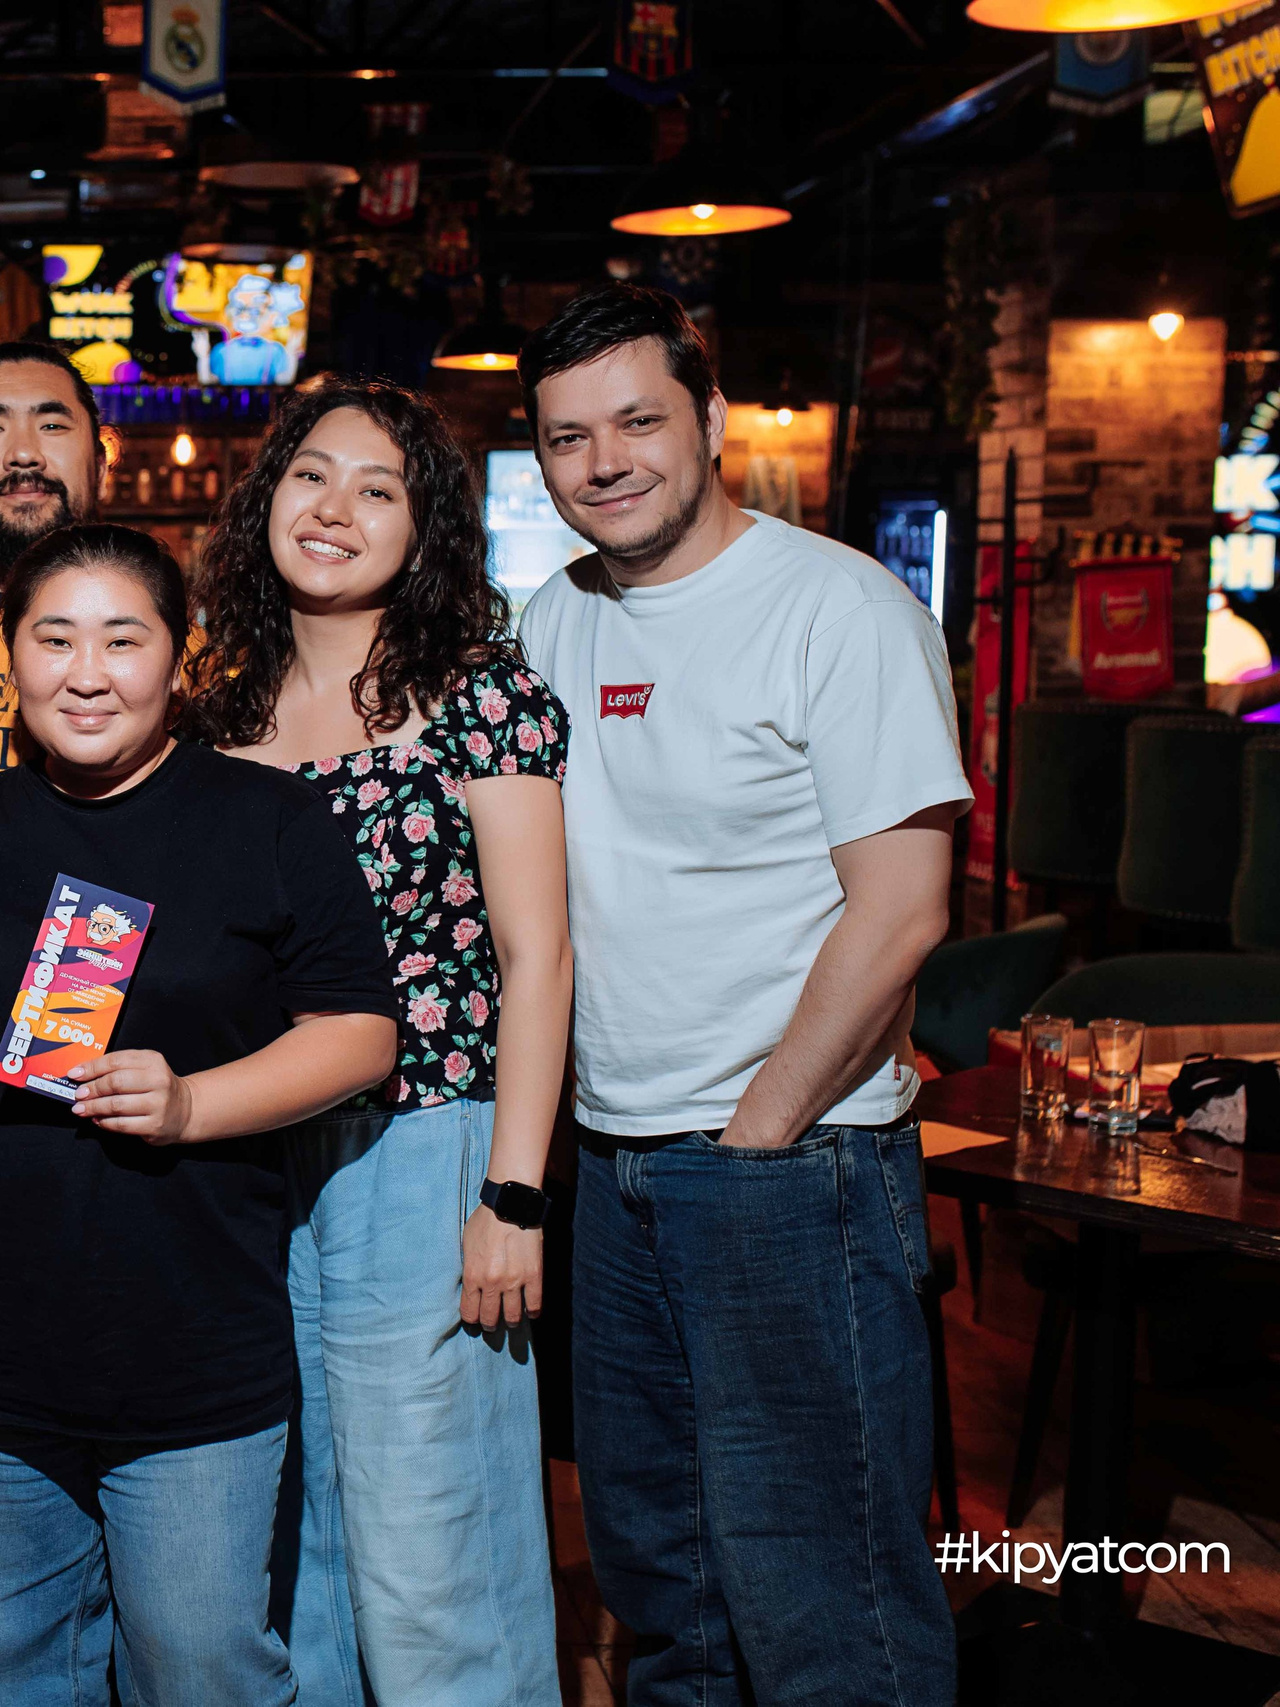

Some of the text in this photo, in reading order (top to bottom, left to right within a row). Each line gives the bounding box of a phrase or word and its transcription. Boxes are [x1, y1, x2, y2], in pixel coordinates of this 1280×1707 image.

[2, 884, 82, 1075] СЕРТИФИКАТ
[59, 972, 125, 997] ДЕНЕЖНЫЙ СЕРТИФИКАТ
[43, 1019, 58, 1034] 7
[58, 1025, 95, 1047] 000
[61, 1016, 92, 1031] НА СУММУ
